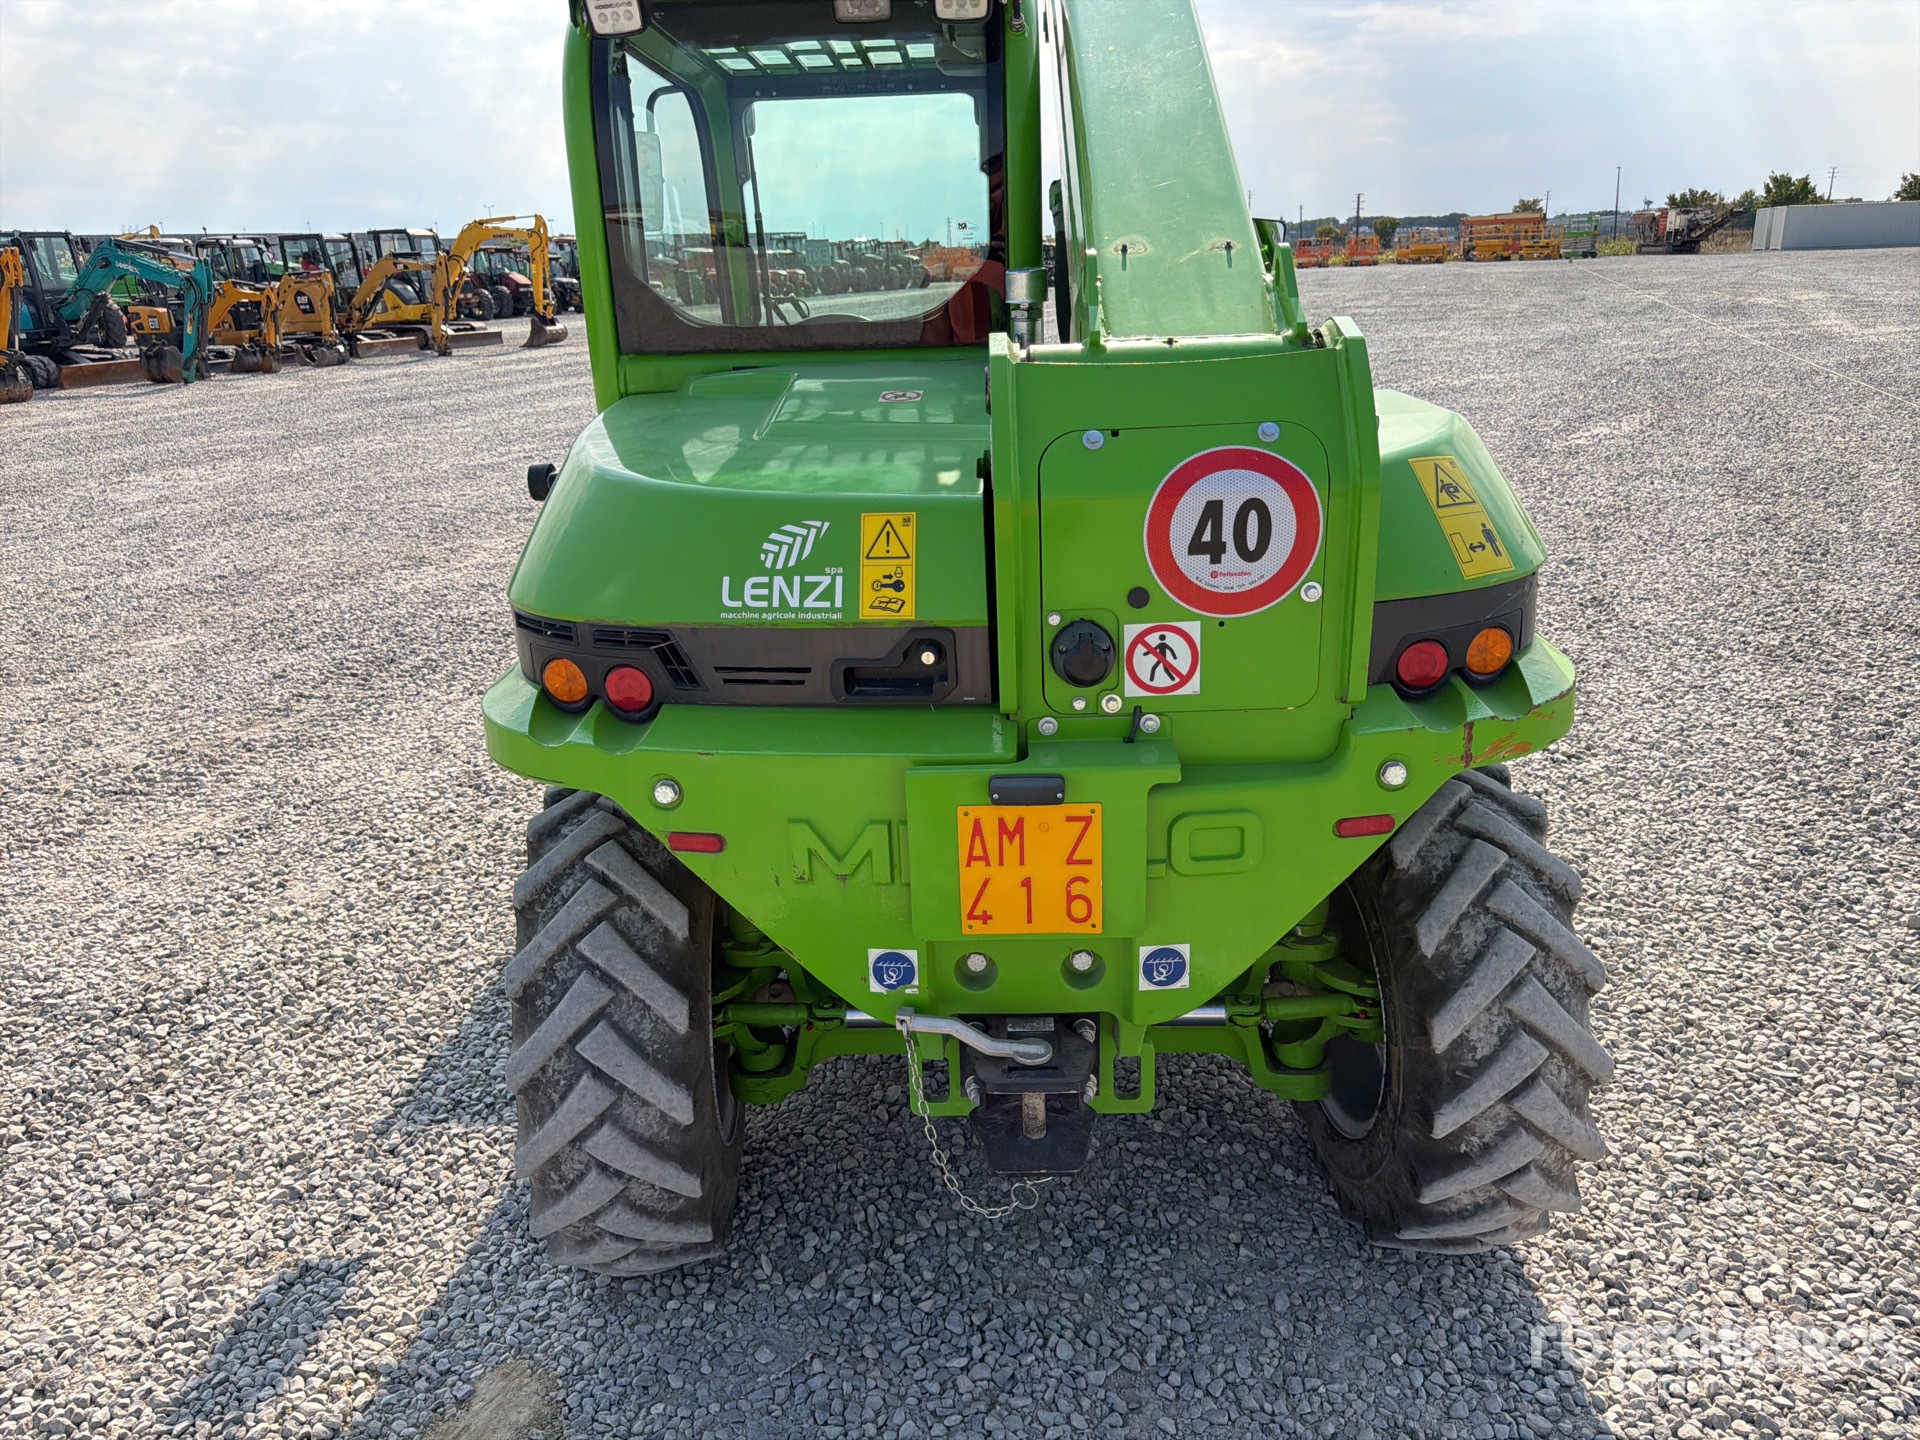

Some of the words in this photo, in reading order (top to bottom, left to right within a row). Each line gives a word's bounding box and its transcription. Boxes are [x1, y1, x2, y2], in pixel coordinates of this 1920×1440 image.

[296, 295, 308, 304] CAT
[1187, 496, 1273, 565] 40
[824, 566, 843, 575] spa
[721, 575, 843, 608] LENZI
[720, 611, 760, 619] macchine
[761, 611, 796, 621] agricole
[798, 611, 843, 620] industriali
[966, 815, 1026, 868] AM
[1065, 814, 1094, 866] Z
